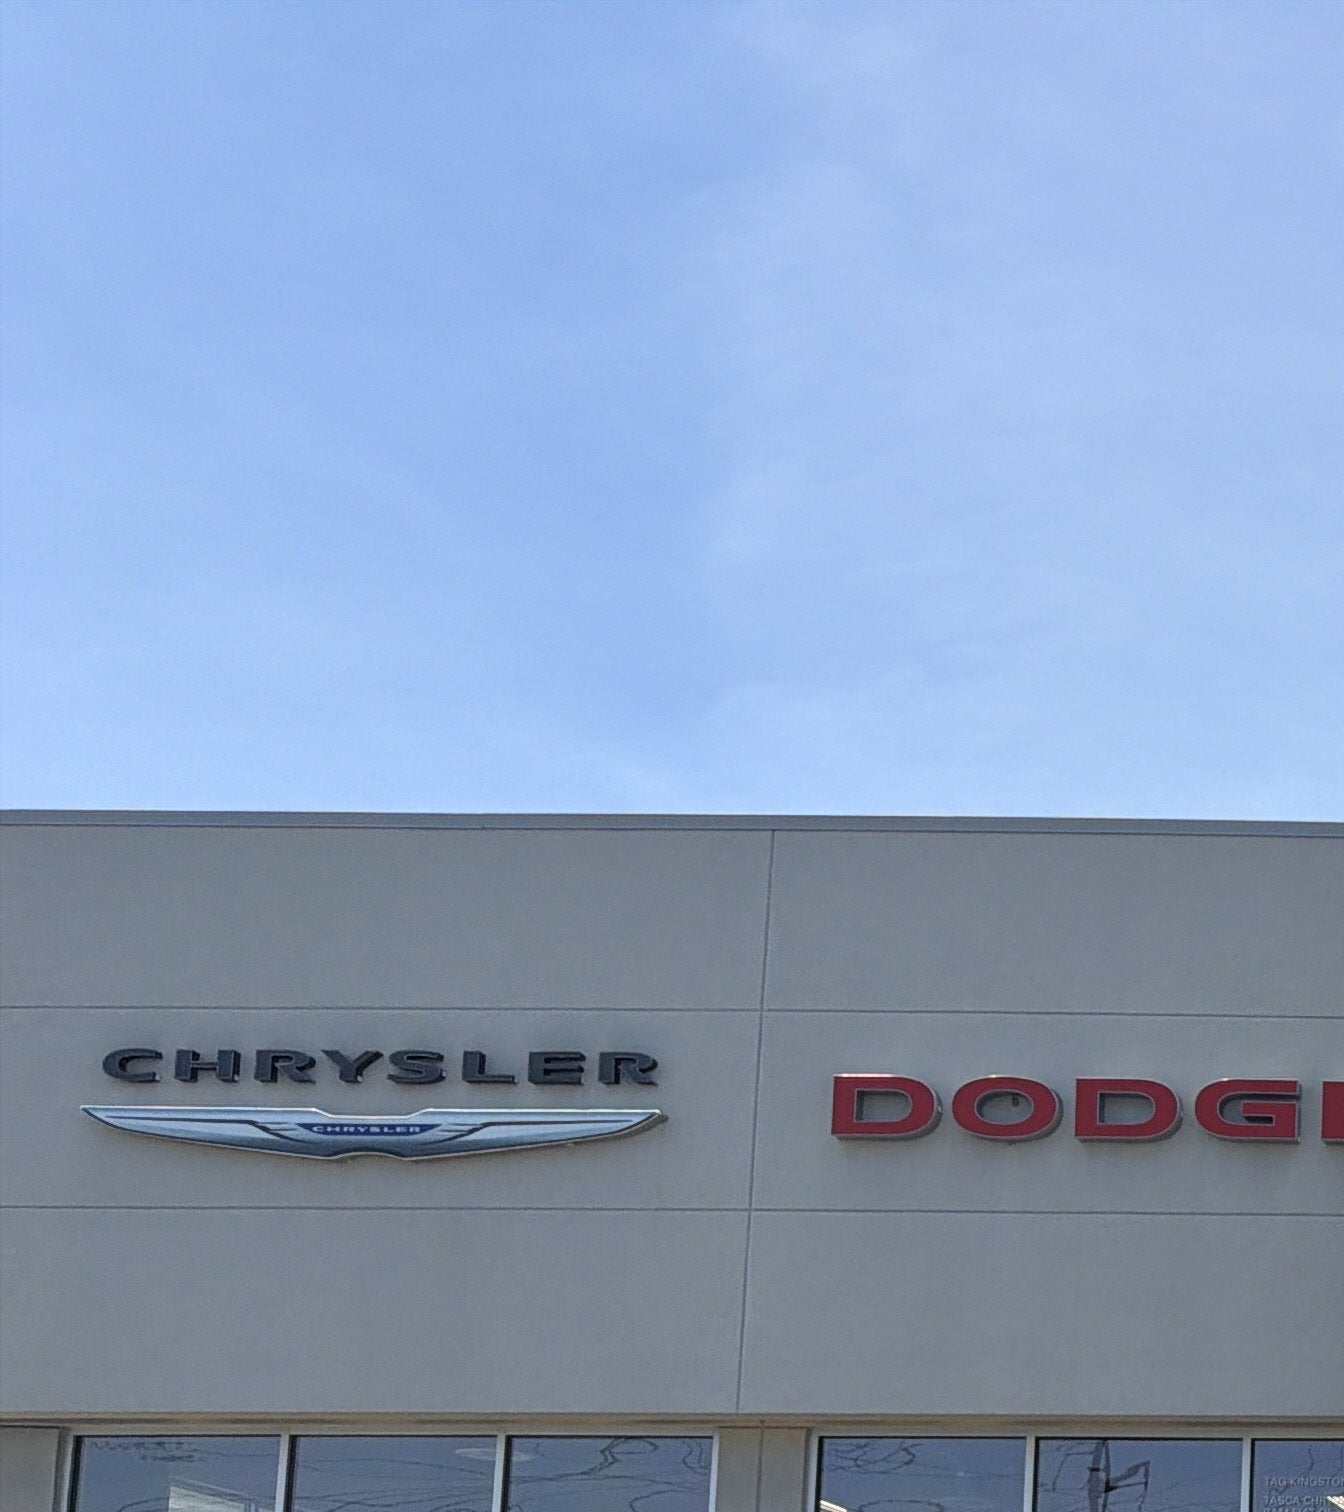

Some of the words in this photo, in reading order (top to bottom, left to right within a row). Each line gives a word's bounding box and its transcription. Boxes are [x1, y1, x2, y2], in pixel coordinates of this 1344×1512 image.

[102, 1048, 658, 1086] CHRYSLER
[312, 1125, 421, 1133] CHRYSLER
[1266, 1476, 1287, 1487] TAG
[1264, 1495, 1300, 1506] TASCA
